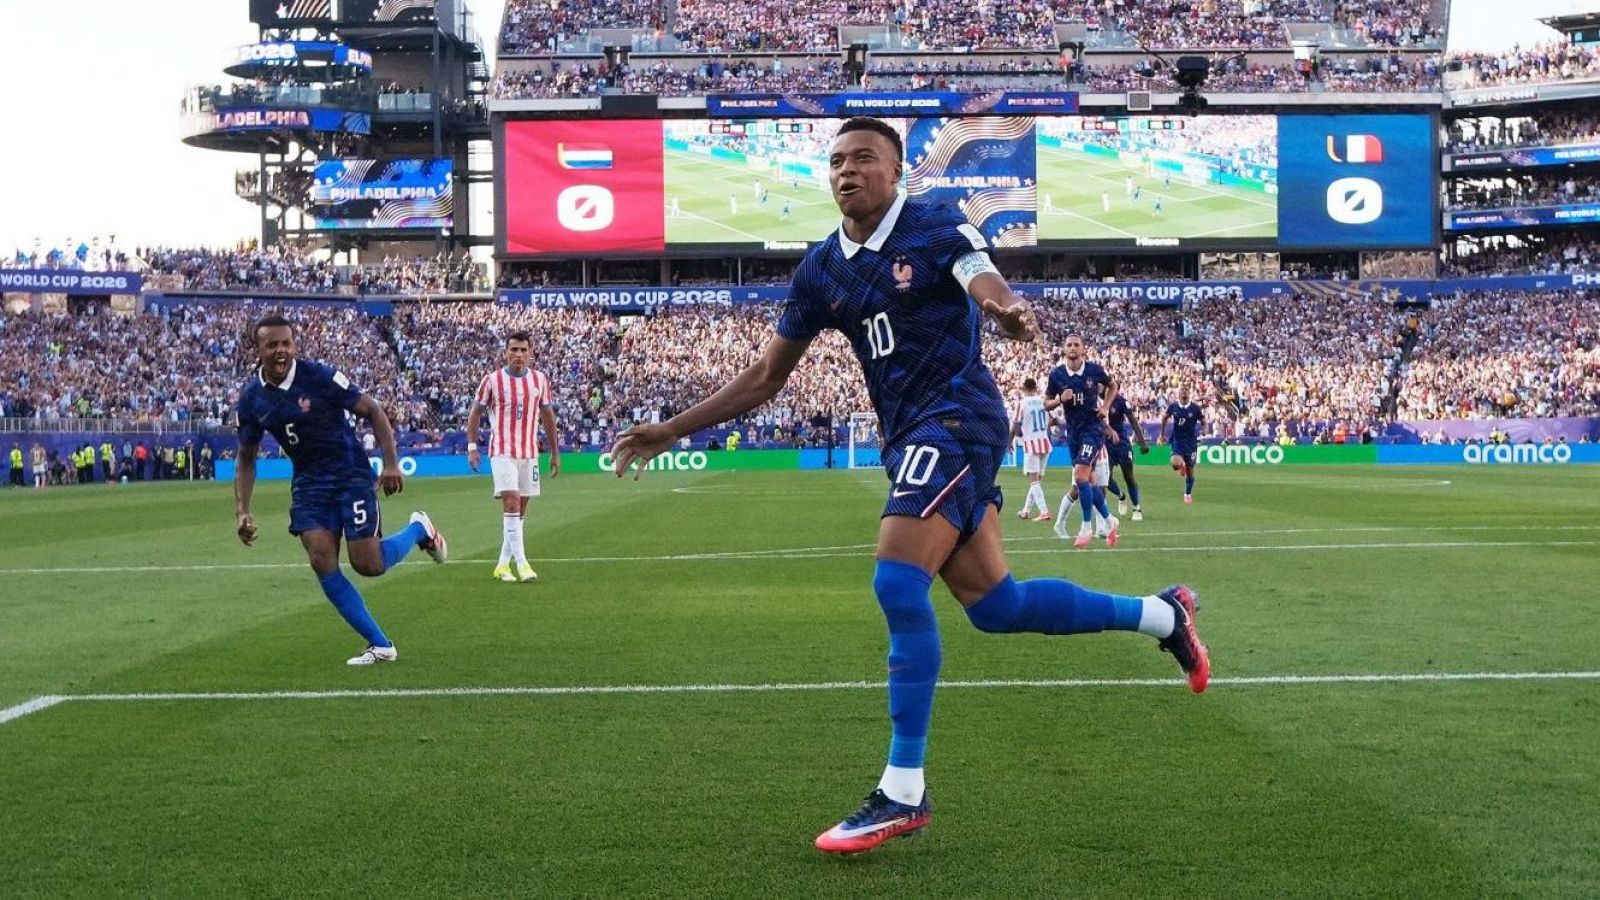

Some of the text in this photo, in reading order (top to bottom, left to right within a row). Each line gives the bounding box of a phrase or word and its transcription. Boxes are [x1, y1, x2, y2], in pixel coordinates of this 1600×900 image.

[720, 100, 778, 108] PHILADELPHIA
[846, 99, 864, 107] FIFA
[865, 99, 894, 107] WORLD
[895, 99, 911, 107] CUP
[922, 175, 1021, 188] PHILADELPHIA
[330, 186, 437, 200] PHILADELPHIA
[0, 273, 128, 288] WORLD CUP 2026
[531, 293, 567, 306] FIFA
[569, 292, 632, 306] WORLD
[634, 291, 669, 305] CUP
[671, 290, 732, 305] 2026
[1043, 287, 1080, 300] FIFA
[1081, 286, 1144, 300] WORLD
[1146, 286, 1180, 299] CUP
[861, 311, 895, 360] 10
[1072, 392, 1084, 406] 14
[1030, 409, 1047, 432] 10
[285, 422, 299, 446] 5
[1081, 444, 1093, 457] 14
[1196, 444, 1285, 464] ramco
[1462, 444, 1572, 464] aramco
[532, 464, 539, 482] 6
[896, 445, 940, 487] 10
[352, 499, 368, 526] 5
